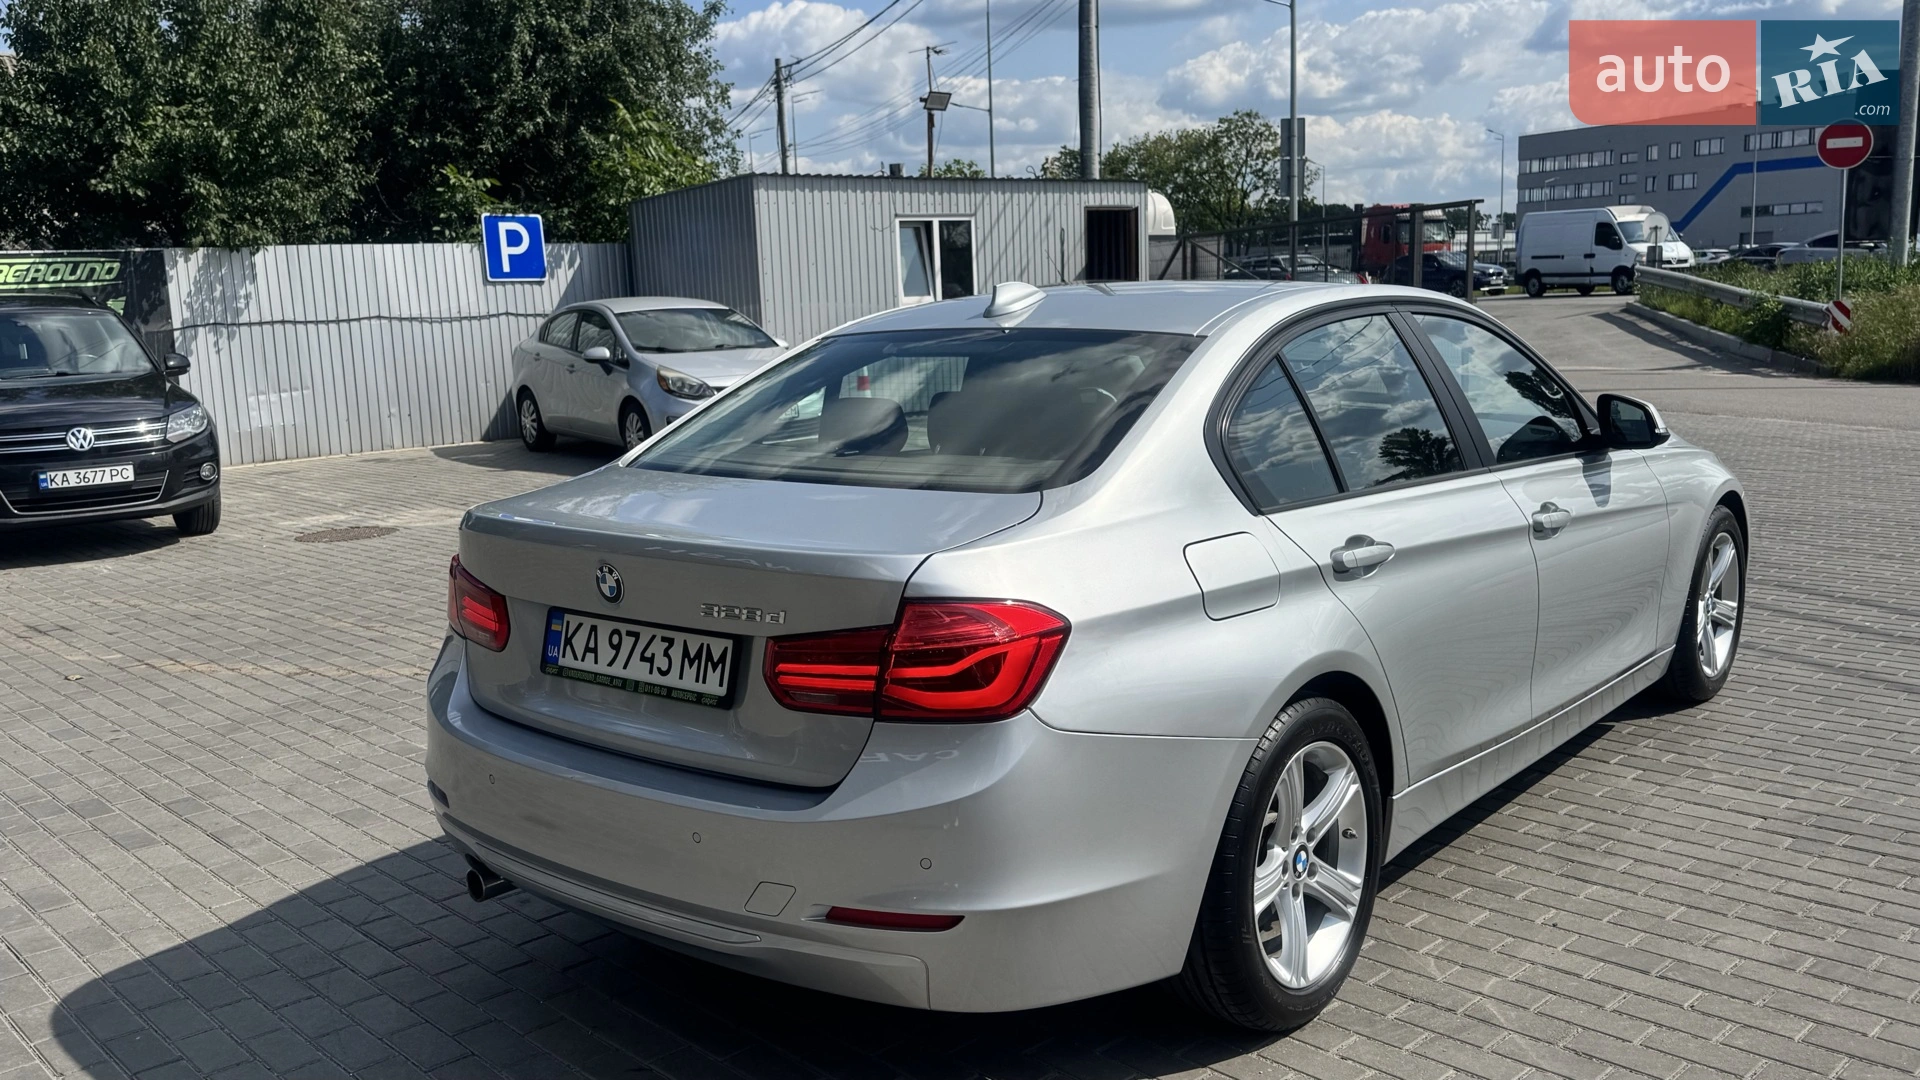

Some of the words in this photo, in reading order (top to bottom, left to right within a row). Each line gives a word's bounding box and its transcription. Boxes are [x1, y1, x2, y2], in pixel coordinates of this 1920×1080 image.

[498, 221, 530, 273] P
[49, 472, 71, 487] KA
[74, 470, 106, 485] 3677
[109, 468, 130, 482] PC
[700, 602, 787, 625] 328d
[547, 645, 559, 658] UA
[561, 620, 600, 664] KA
[606, 628, 676, 677] 9743
[679, 639, 729, 688] MM
